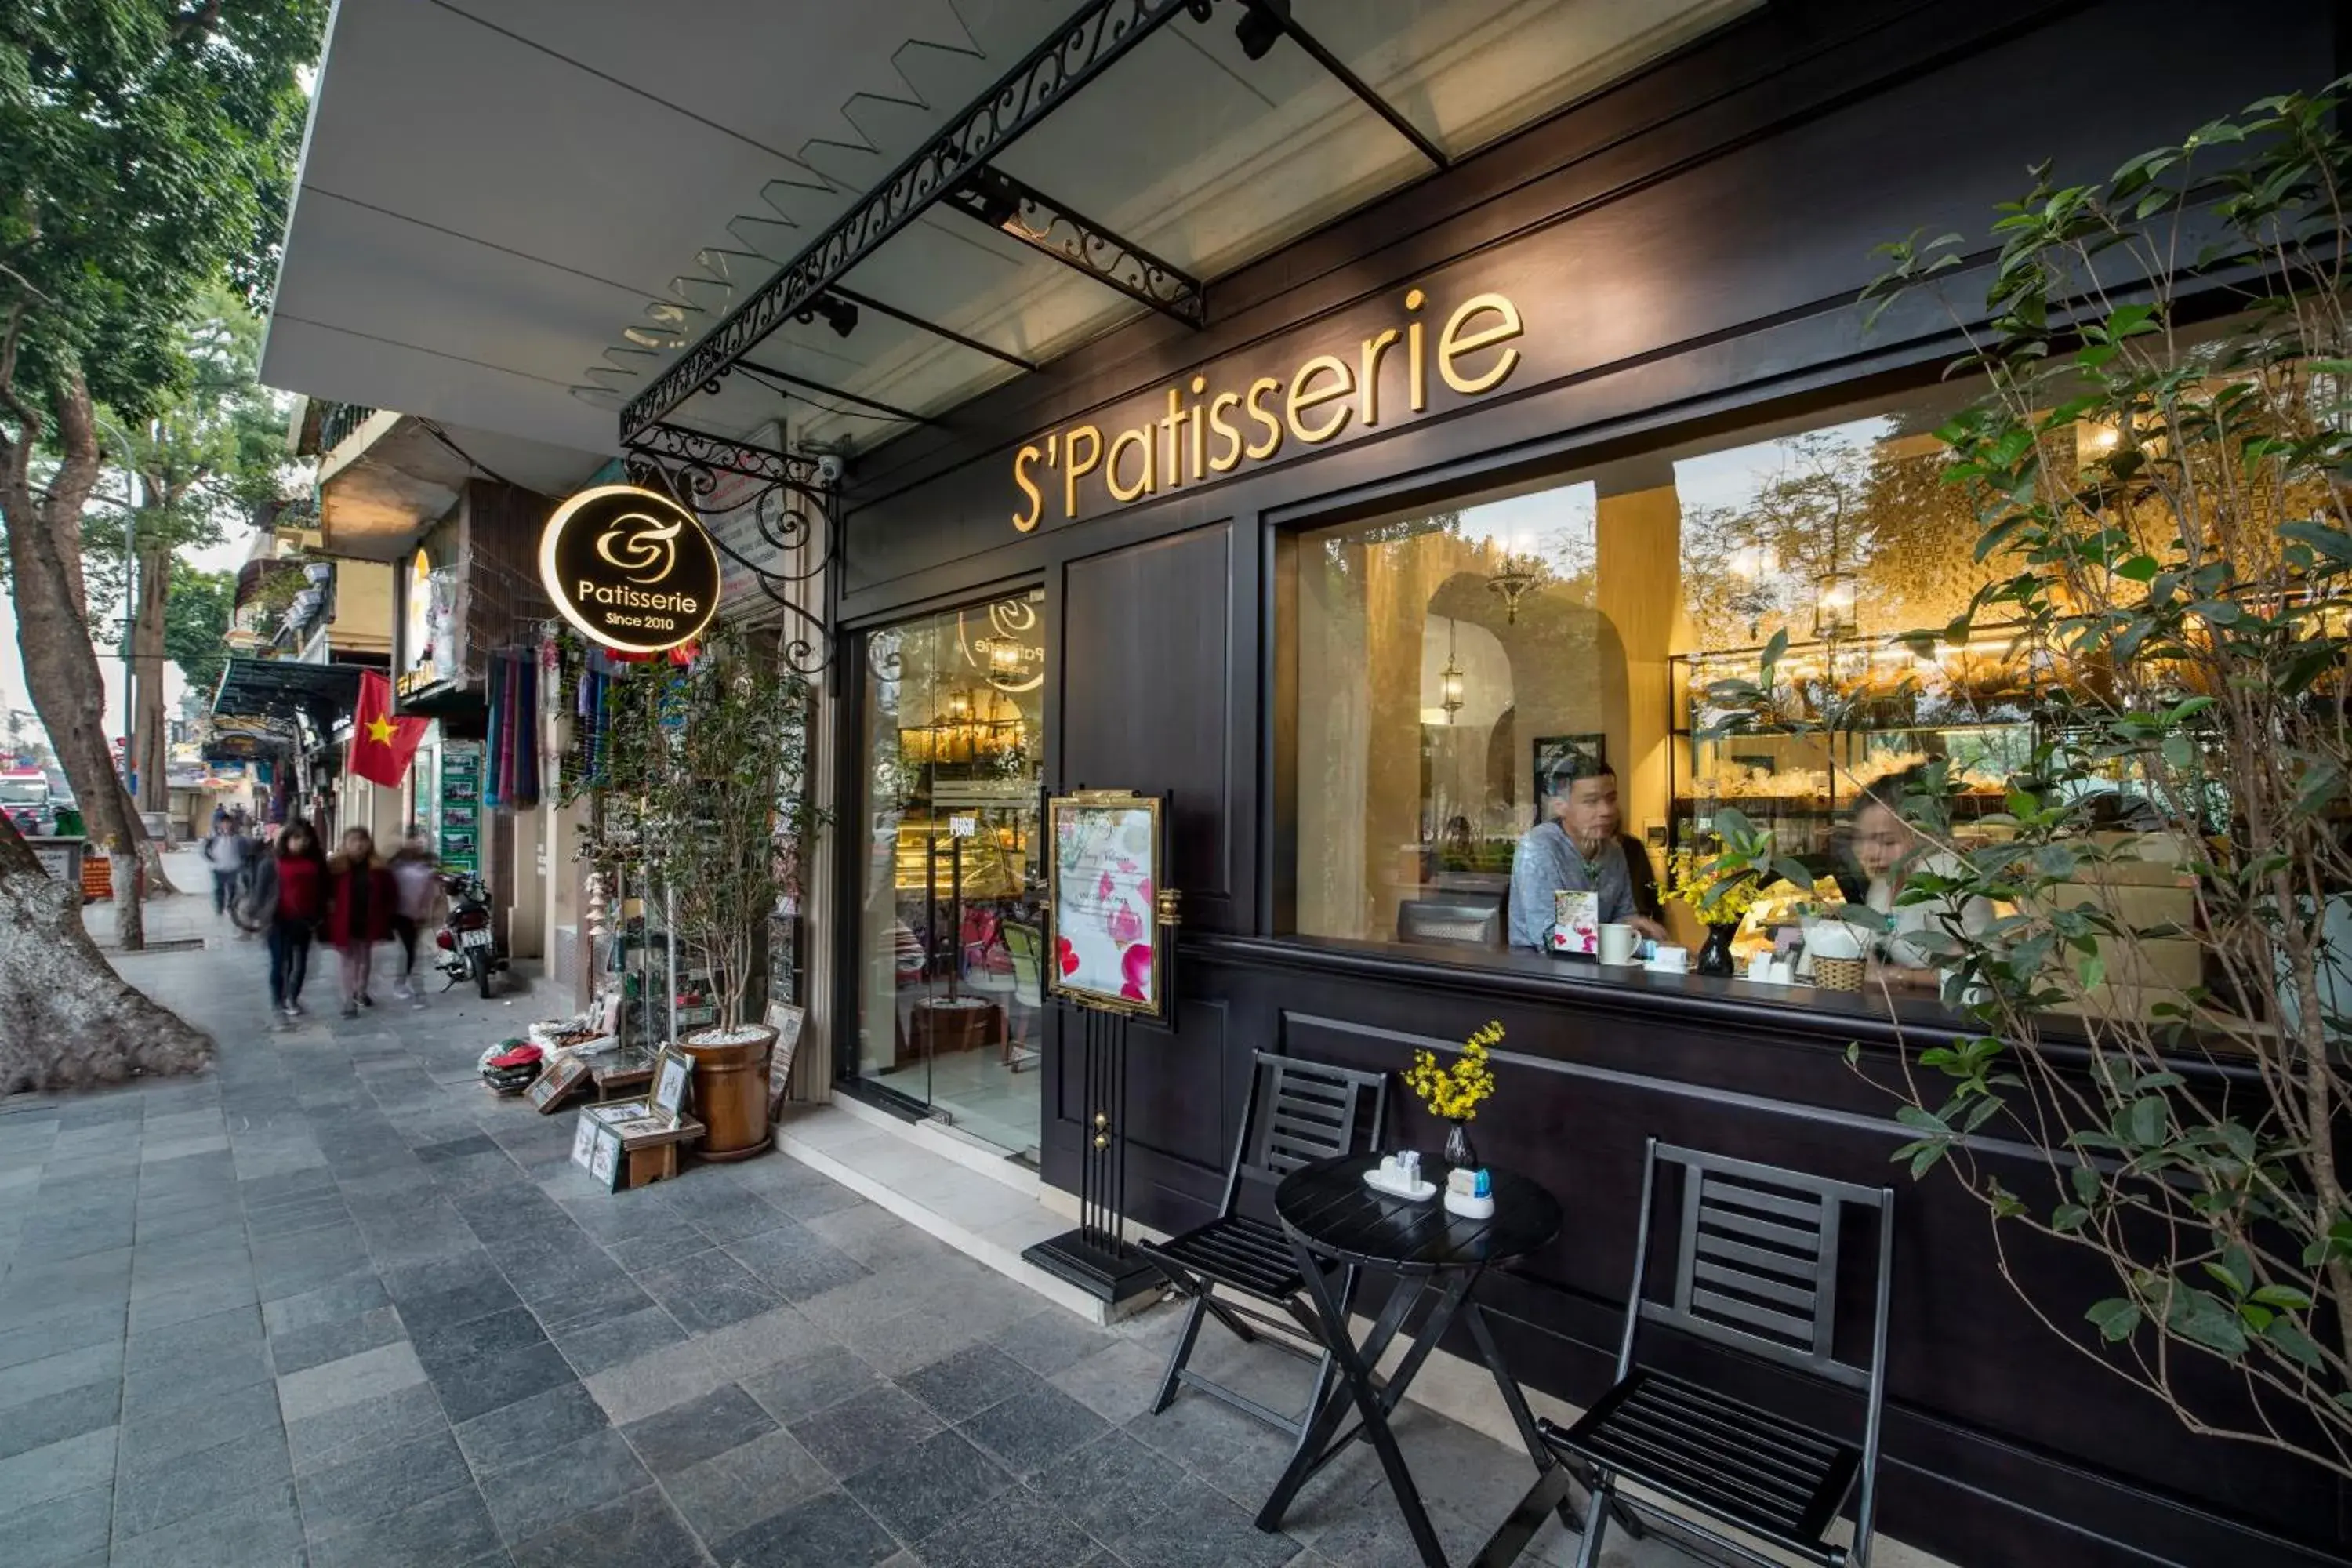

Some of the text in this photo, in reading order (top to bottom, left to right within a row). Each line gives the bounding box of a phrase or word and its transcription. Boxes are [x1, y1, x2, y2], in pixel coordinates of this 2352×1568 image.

[1012, 289, 1523, 532] S'Patisserie
[579, 580, 697, 613] Patisserie
[605, 612, 674, 630] Since 2010
[950, 816, 975, 837] PUSH
